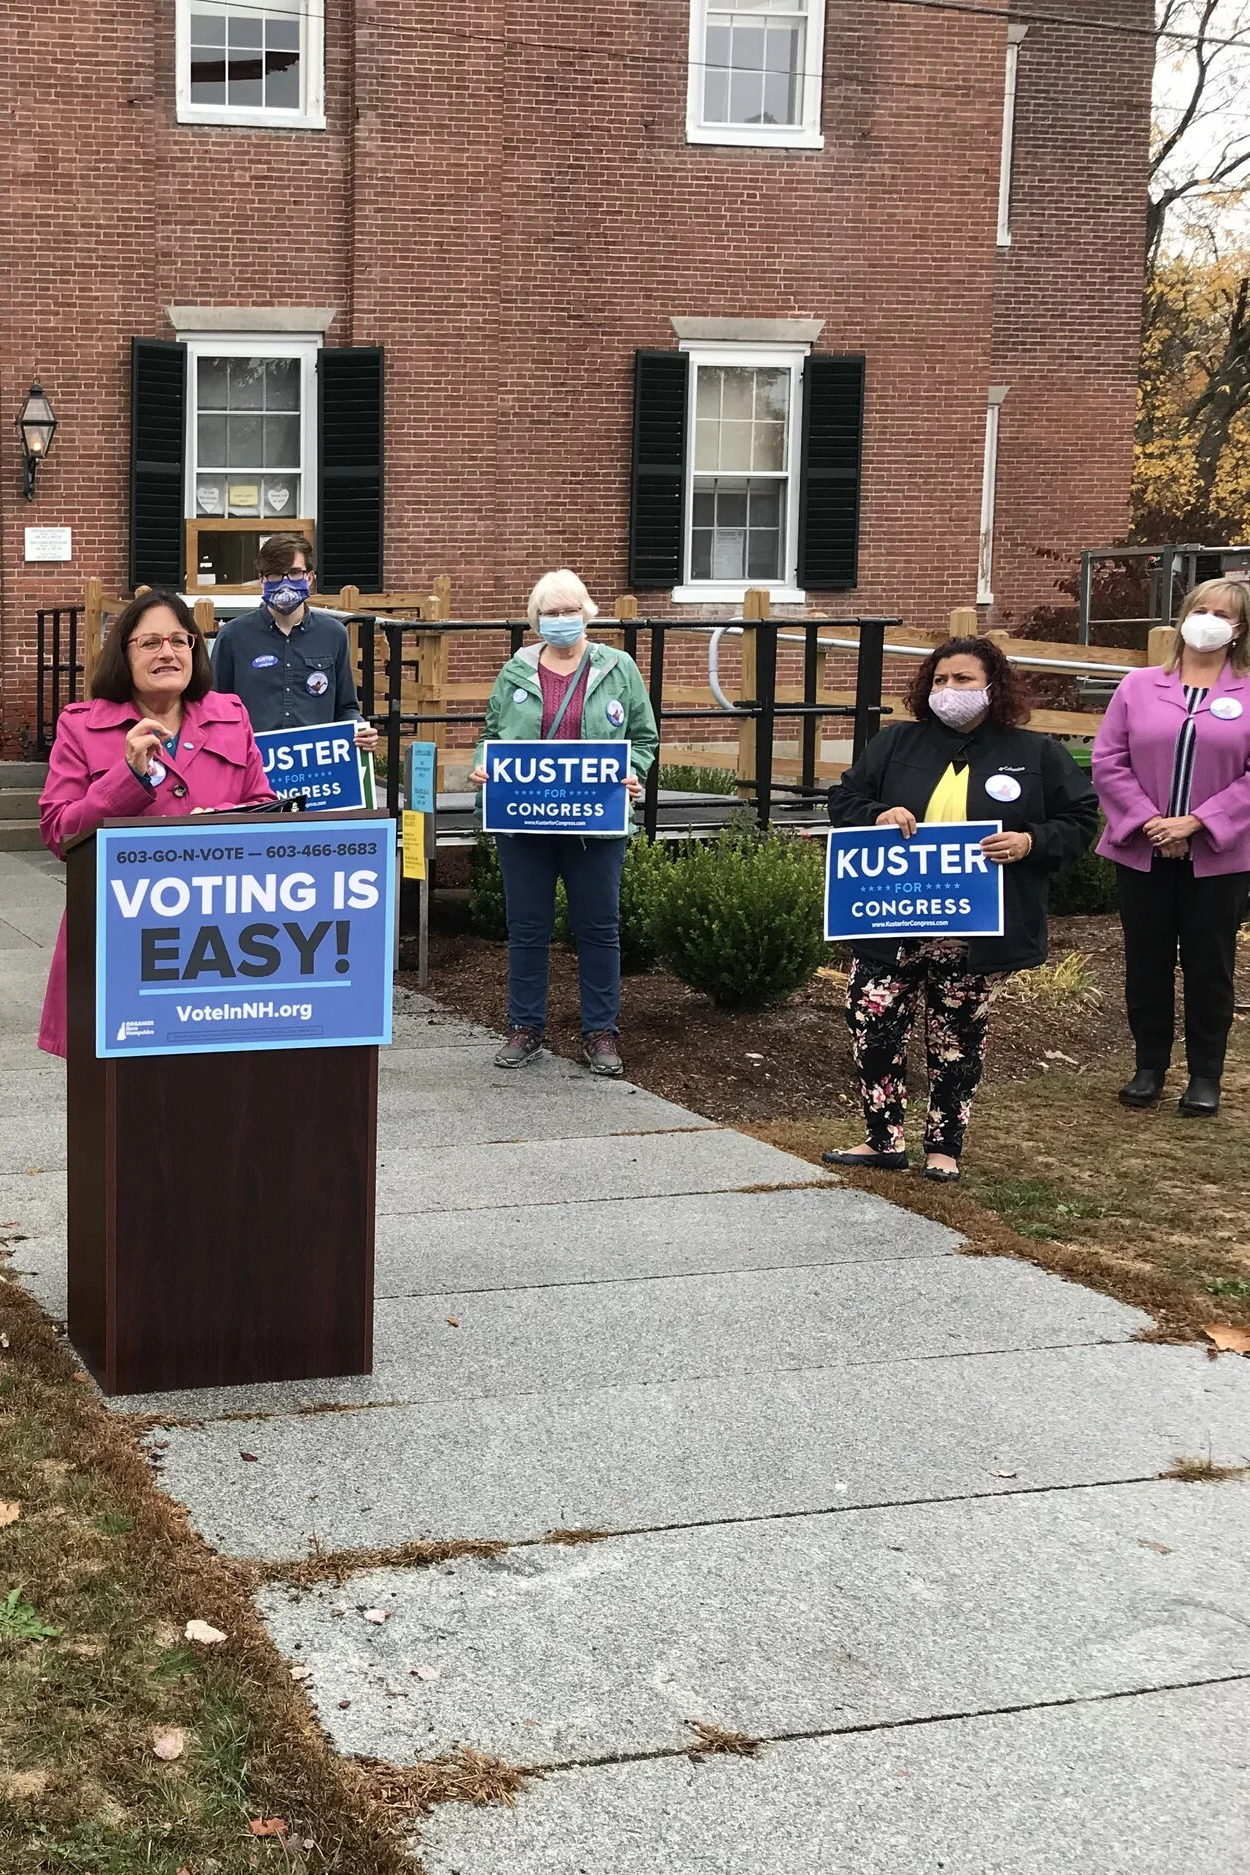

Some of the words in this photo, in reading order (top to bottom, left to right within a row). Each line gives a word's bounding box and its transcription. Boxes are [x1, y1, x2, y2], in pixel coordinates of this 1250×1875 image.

[263, 738, 350, 773] USTER
[285, 774, 305, 783] FOR
[493, 757, 620, 783] KUSTER
[276, 782, 341, 800] NGRESS
[544, 789, 566, 798] FOR
[506, 803, 604, 817] CONGRESS
[116, 847, 244, 864] 603-GO-N-VOTE
[266, 842, 377, 859] 603-466-8683
[837, 843, 988, 879] KUSTER
[111, 872, 317, 918] VOTING
[334, 869, 380, 910] IS
[894, 882, 922, 893] FOR
[851, 898, 971, 918] CONGRESS
[872, 920, 949, 928] www.KusterforCongress.com
[141, 920, 351, 982] EASY!
[176, 1002, 312, 1022] VoteInNH.org
